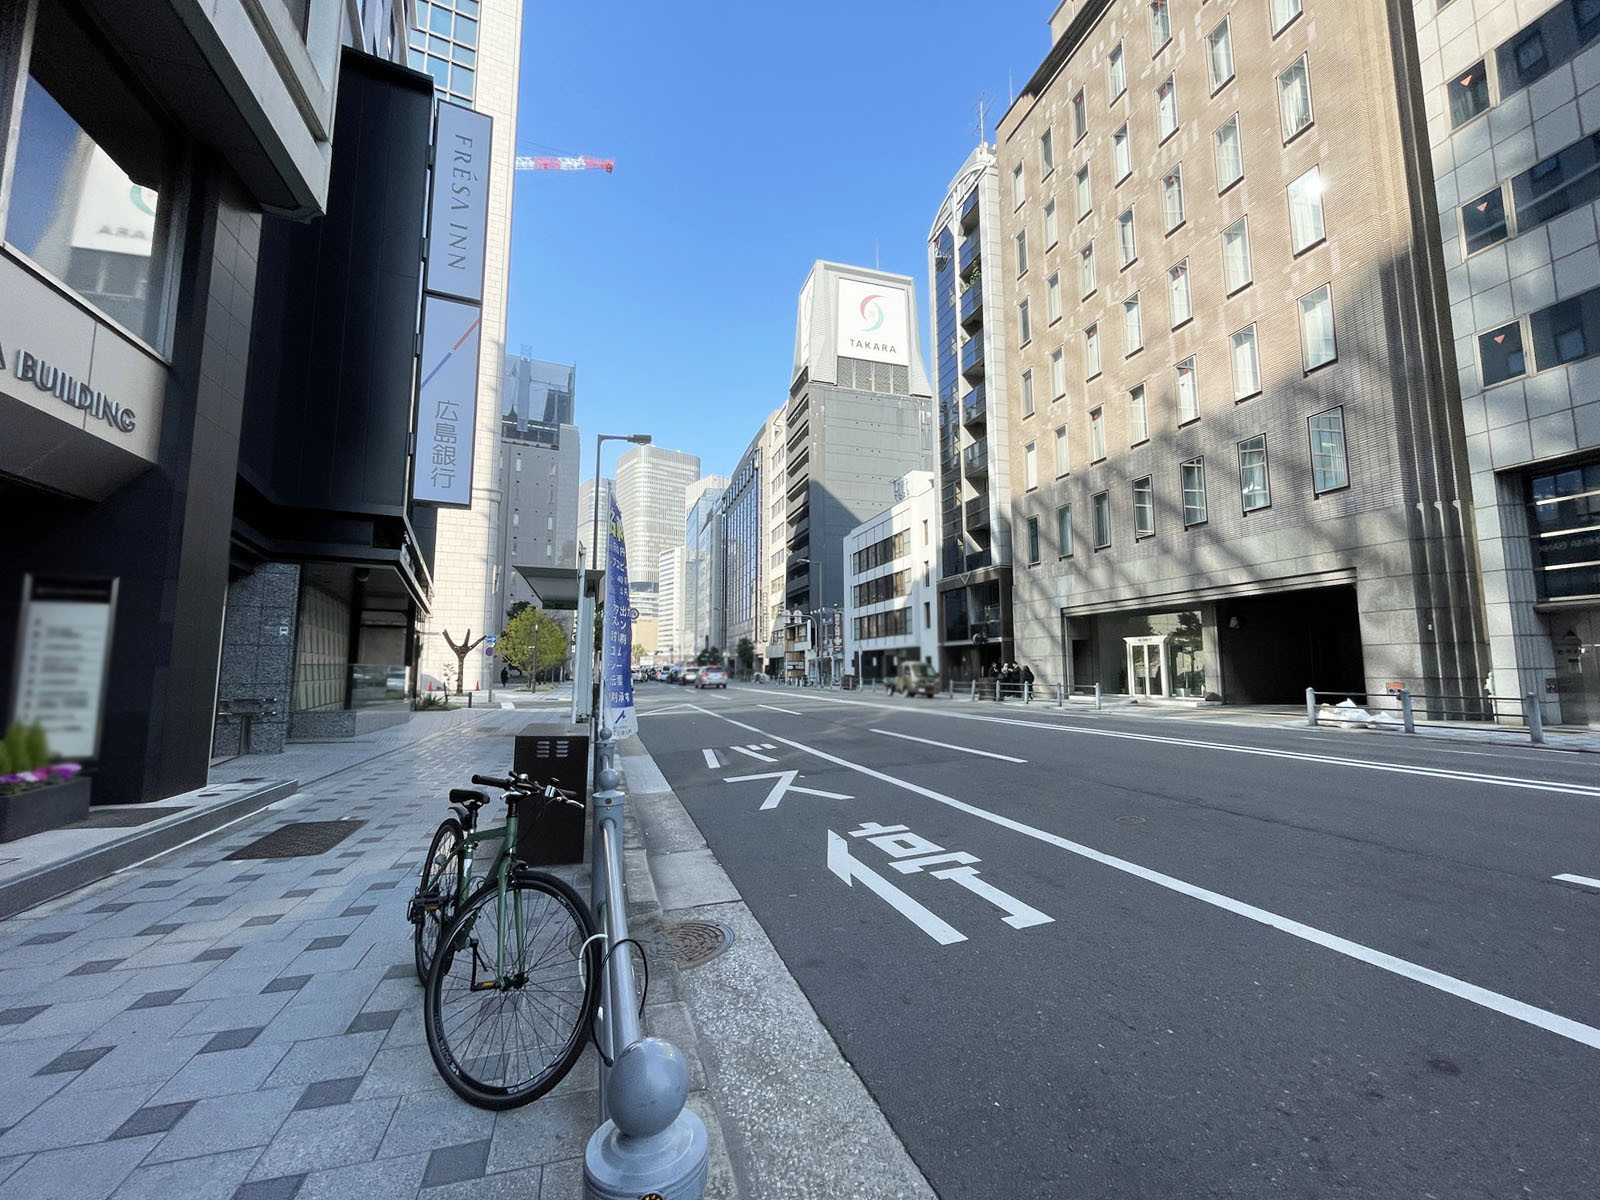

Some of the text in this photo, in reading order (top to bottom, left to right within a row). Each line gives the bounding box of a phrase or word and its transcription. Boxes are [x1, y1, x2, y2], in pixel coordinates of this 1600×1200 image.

[447, 222, 469, 270] INN
[849, 338, 897, 354] TAKARA
[16, 349, 136, 433] BUILDING
[430, 400, 460, 489] 広島銀行
